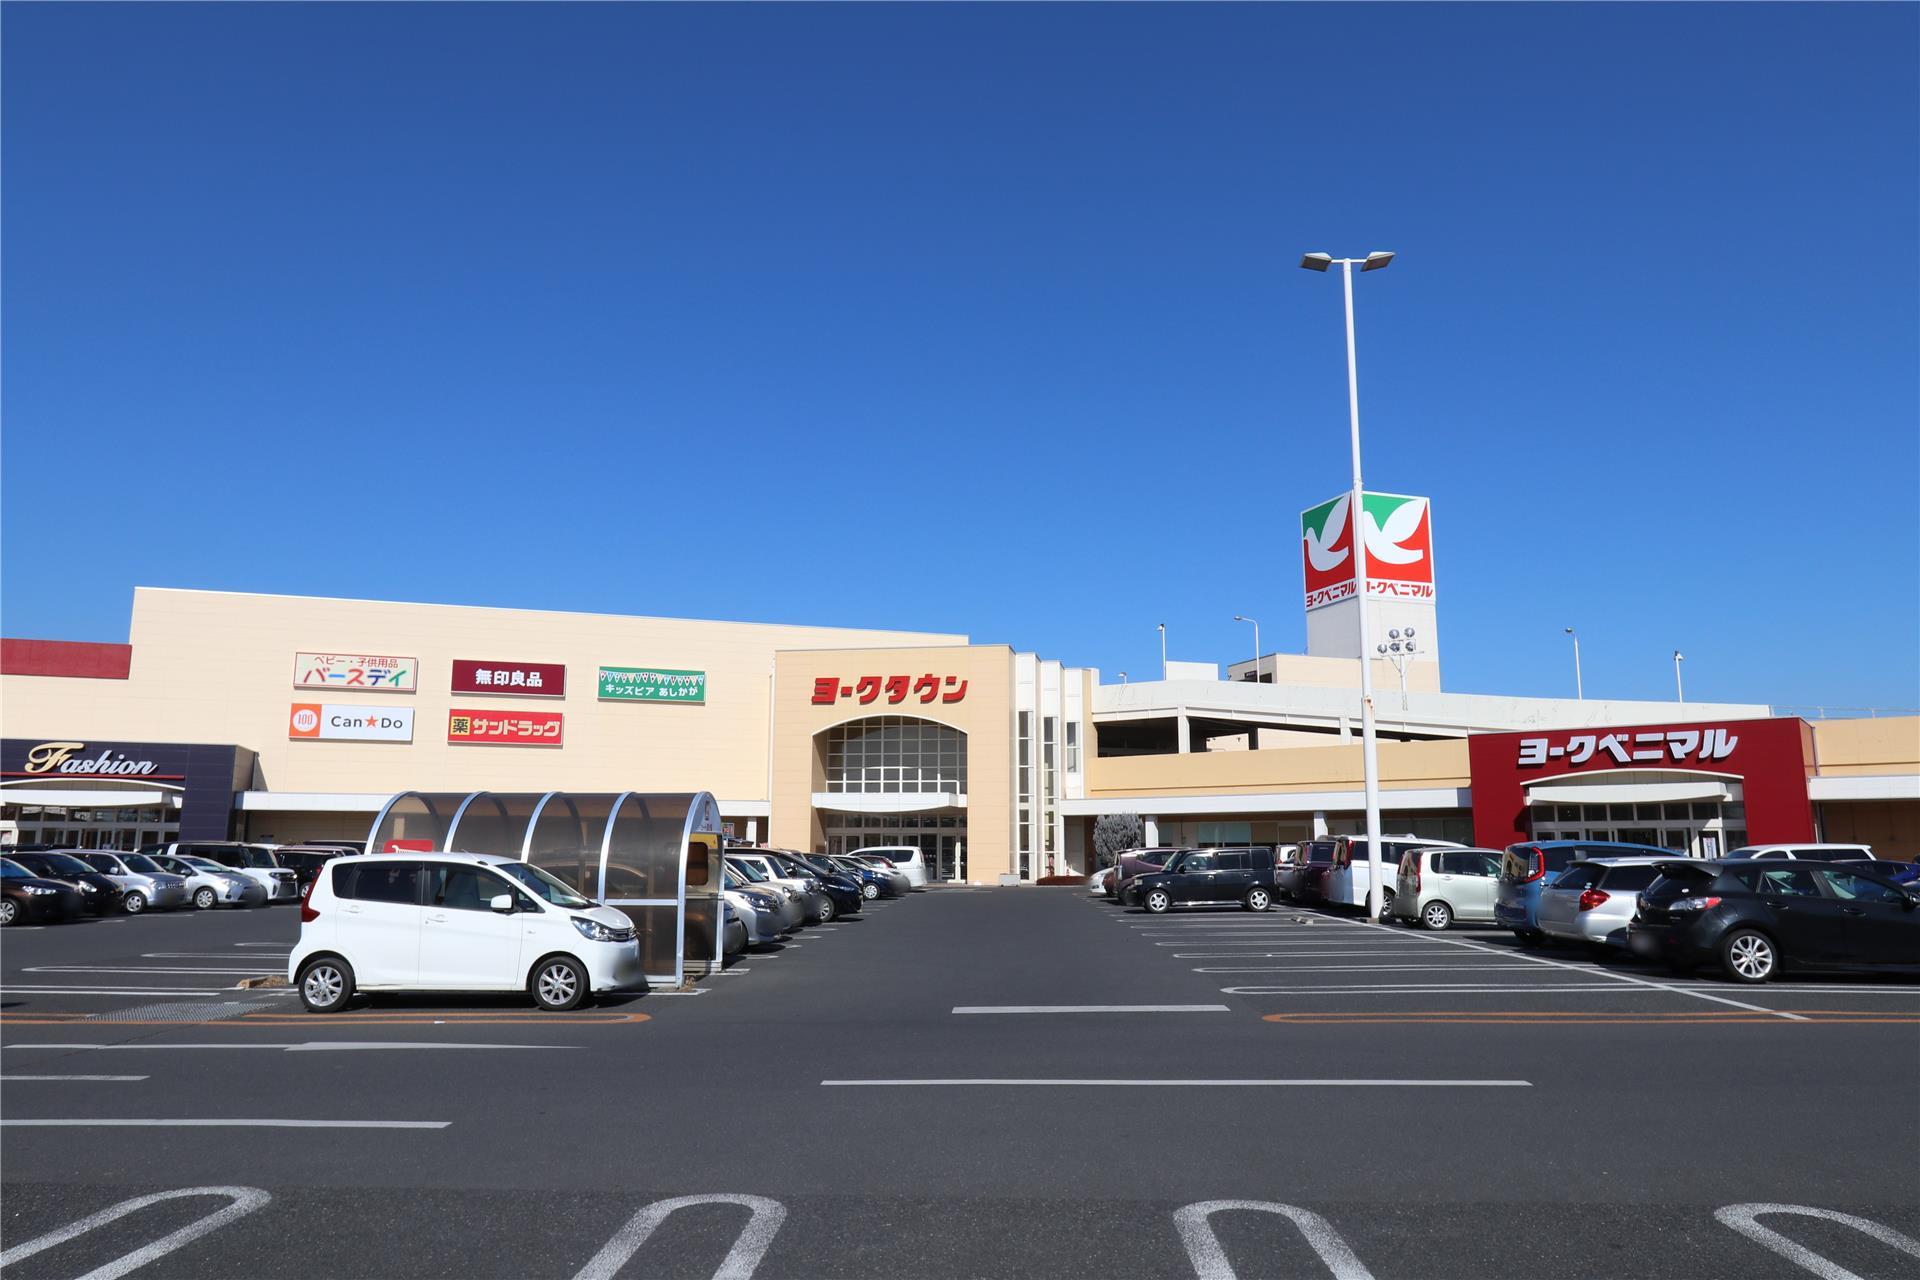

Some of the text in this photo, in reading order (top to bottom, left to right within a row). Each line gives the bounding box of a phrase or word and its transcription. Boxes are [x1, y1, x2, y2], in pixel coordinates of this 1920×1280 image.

[1306, 581, 1357, 608] ヨークベニマル
[475, 669, 543, 687] 無印良品
[659, 686, 698, 697] あしかが
[811, 673, 968, 705] ヨークタウン
[452, 718, 560, 737] 薬 サンドラッグ
[24, 741, 158, 775] Fashion
[1517, 728, 1739, 766] ヨークベニマル
